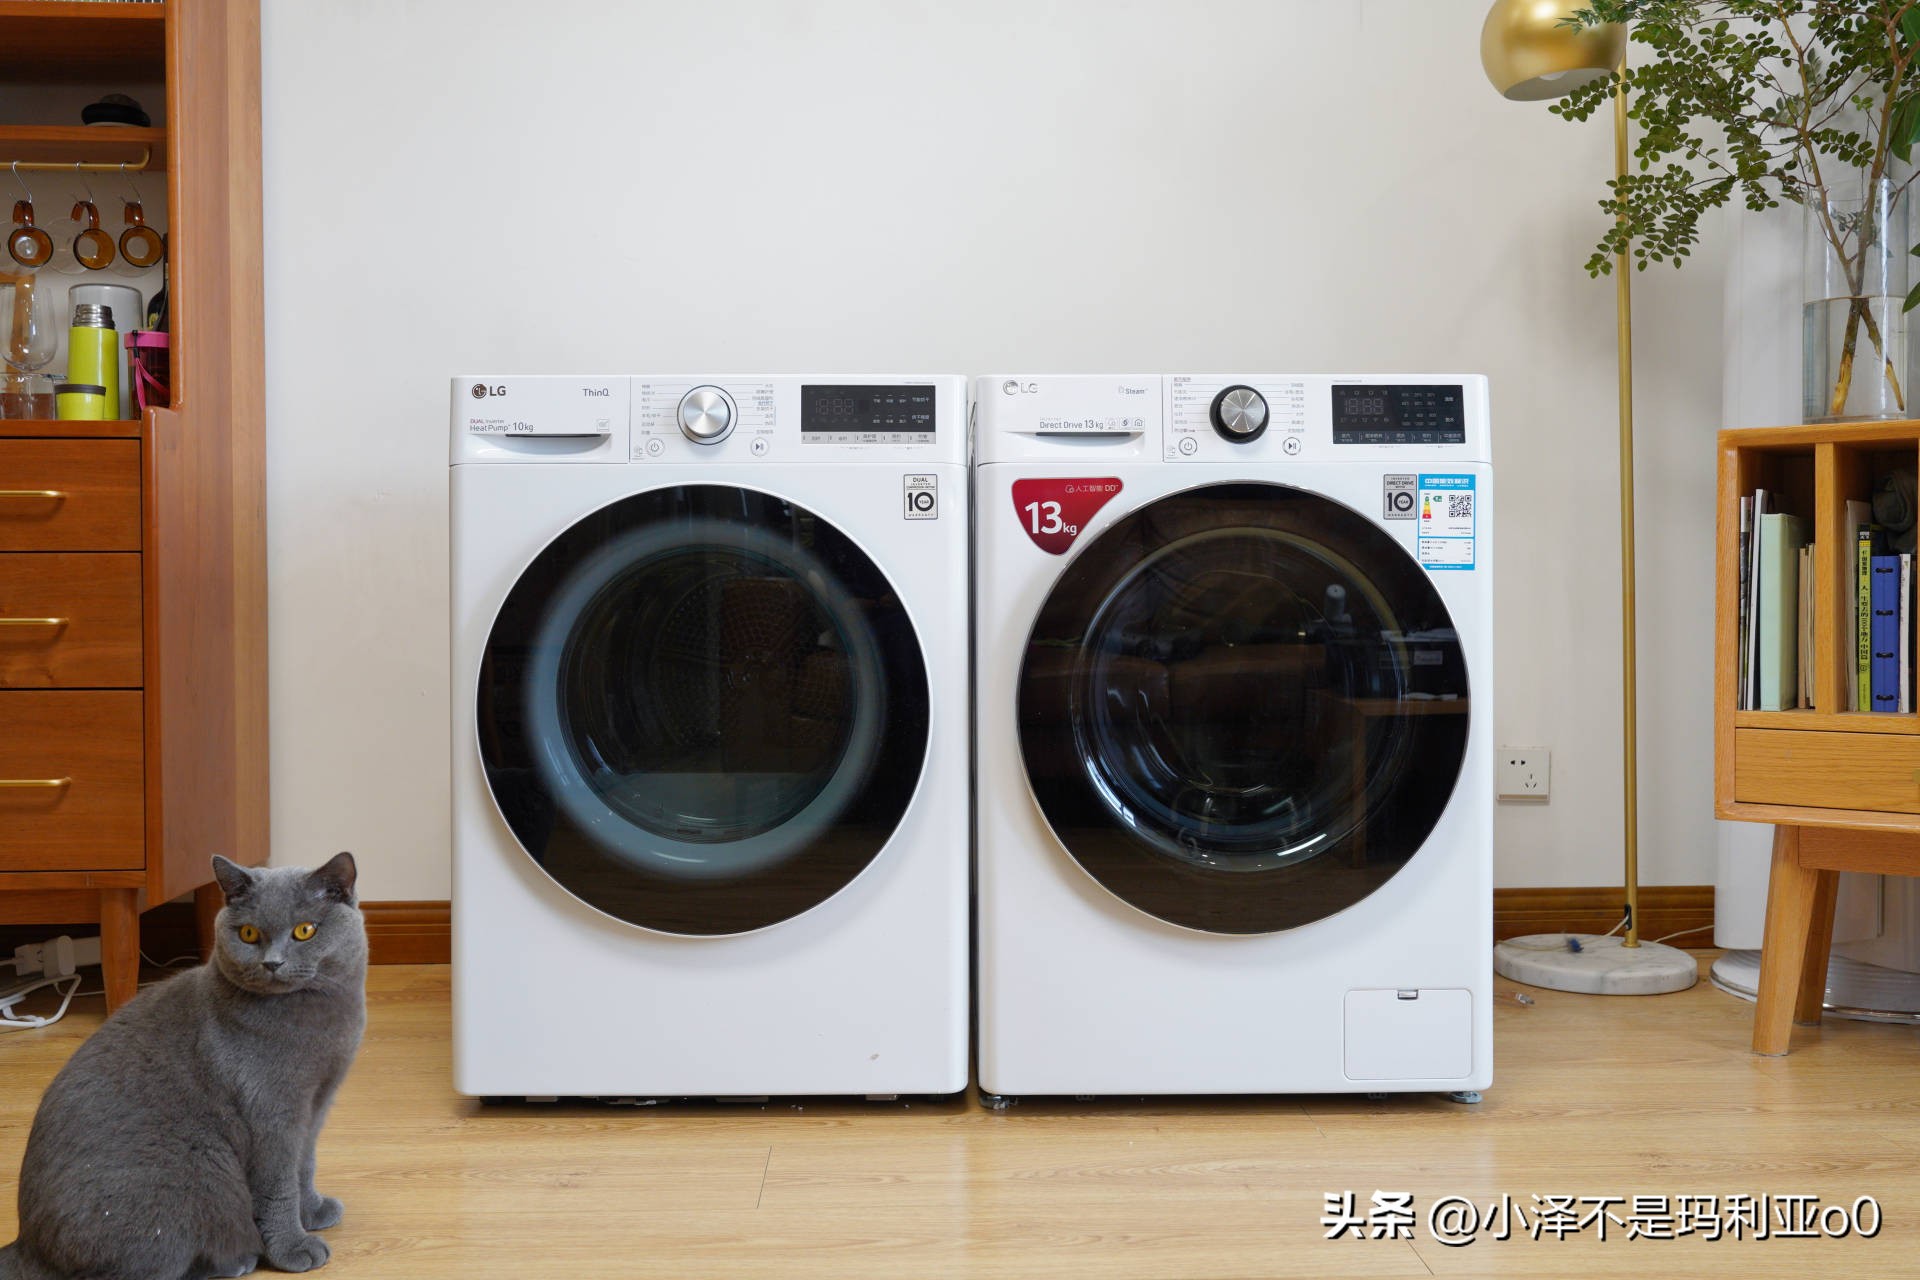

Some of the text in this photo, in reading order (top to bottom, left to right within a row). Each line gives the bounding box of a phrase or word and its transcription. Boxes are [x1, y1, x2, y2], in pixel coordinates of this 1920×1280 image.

[489, 385, 507, 397] LG
[582, 387, 610, 397] ThinQ
[1020, 382, 1039, 394] LG
[470, 424, 487, 432] Heat
[488, 424, 508, 433] Pump
[1039, 421, 1062, 429] Direct
[1063, 421, 1083, 429] Drive
[907, 492, 935, 512] 10
[1387, 492, 1414, 512] 10
